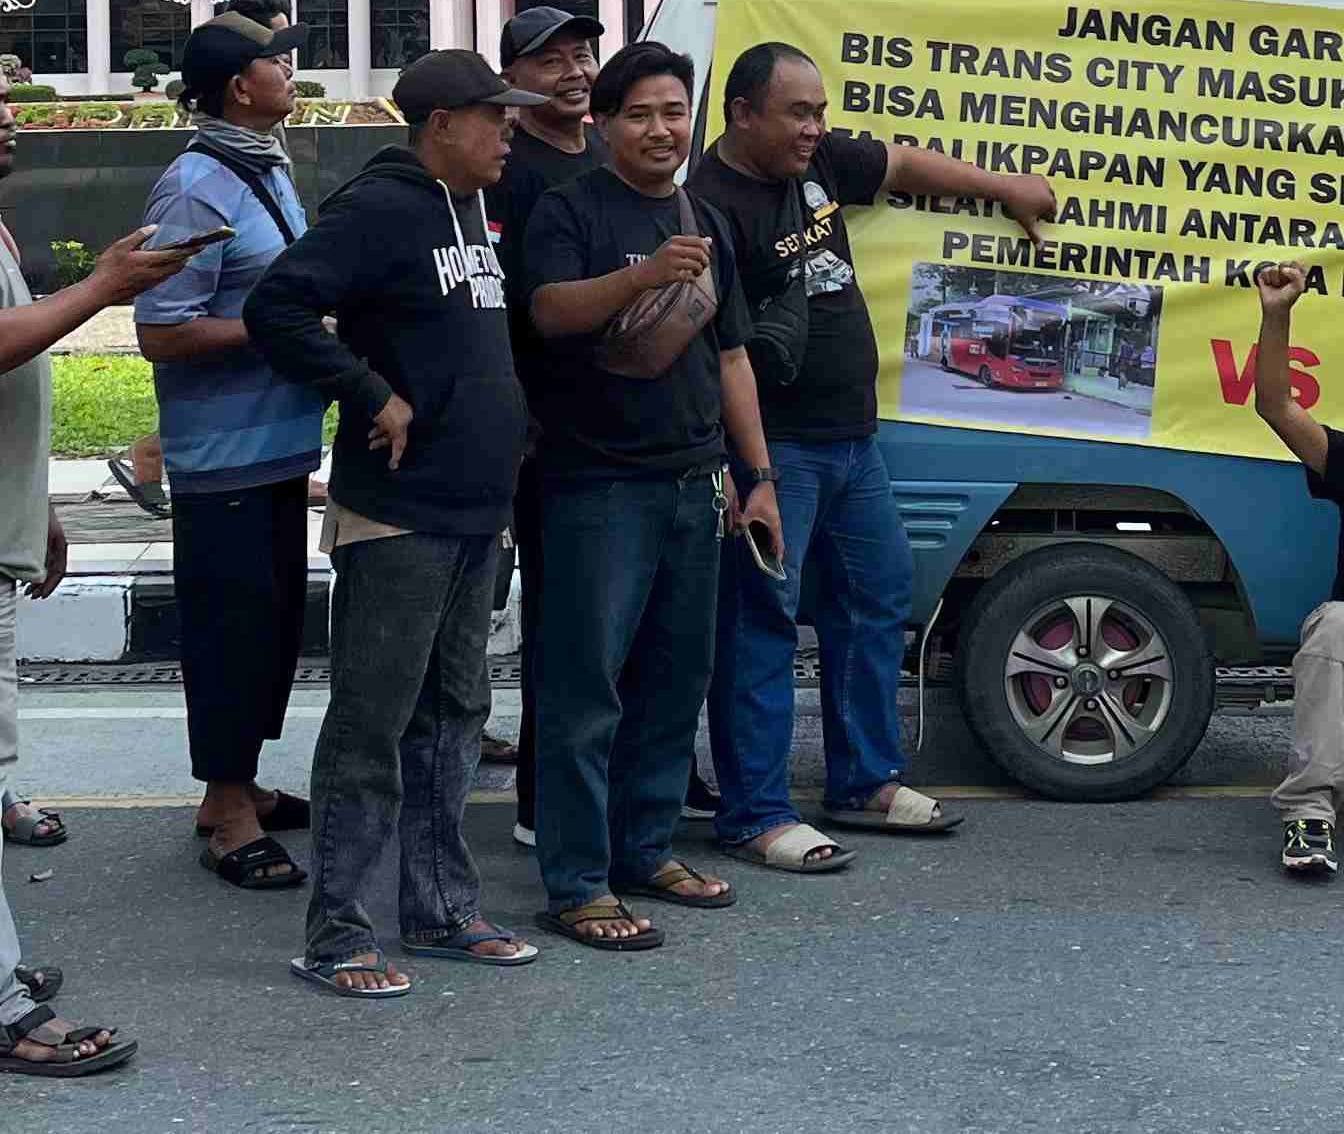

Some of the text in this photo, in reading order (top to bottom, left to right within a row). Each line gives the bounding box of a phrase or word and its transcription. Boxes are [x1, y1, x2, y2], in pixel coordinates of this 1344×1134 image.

[1057, 6, 1235, 52] JANGAN
[841, 32, 913, 68] BIS
[926, 41, 1072, 83] TRANS
[1086, 57, 1185, 93] CITY
[843, 81, 945, 121] BISA
[1179, 159, 1296, 202] YANG
[775, 217, 833, 258] SEKAT
[942, 230, 1211, 284] PEMERINTAH
[1225, 258, 1329, 296] KOA
[1210, 338, 1321, 411] VS
